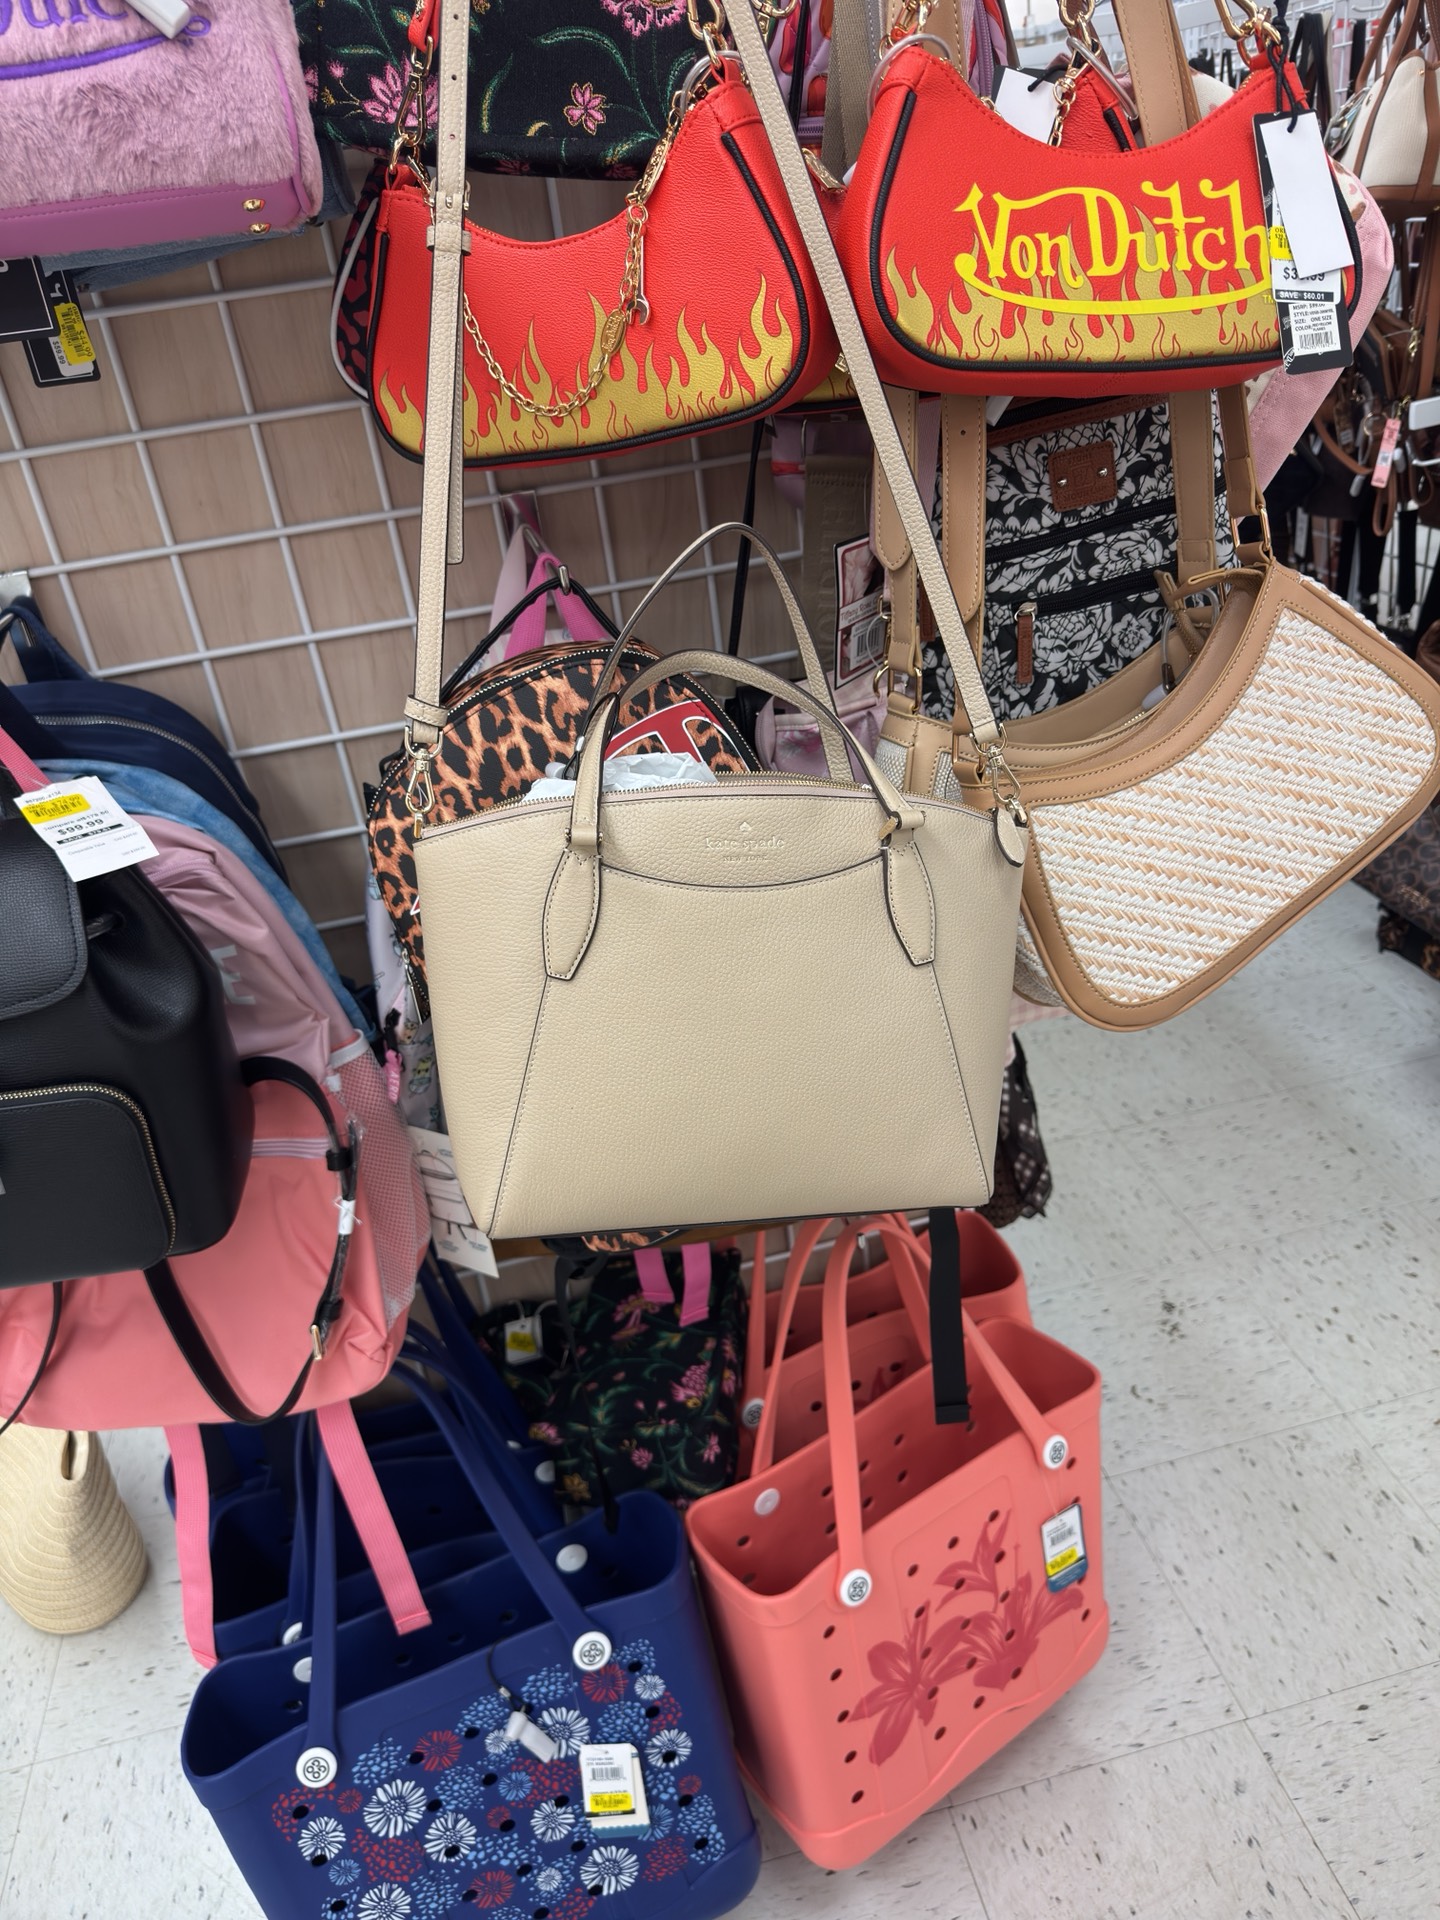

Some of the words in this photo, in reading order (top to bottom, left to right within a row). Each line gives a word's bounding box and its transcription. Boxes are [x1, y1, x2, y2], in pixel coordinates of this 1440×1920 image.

[953, 182, 1083, 288] Von
[1083, 179, 1270, 278] Dutch
[1303, 292, 1325, 300] $60.01
[52, 340, 66, 365] $59.99
[57, 818, 104, 836] $99.99
[706, 837, 738, 850] kate
[742, 836, 785, 854] spade
